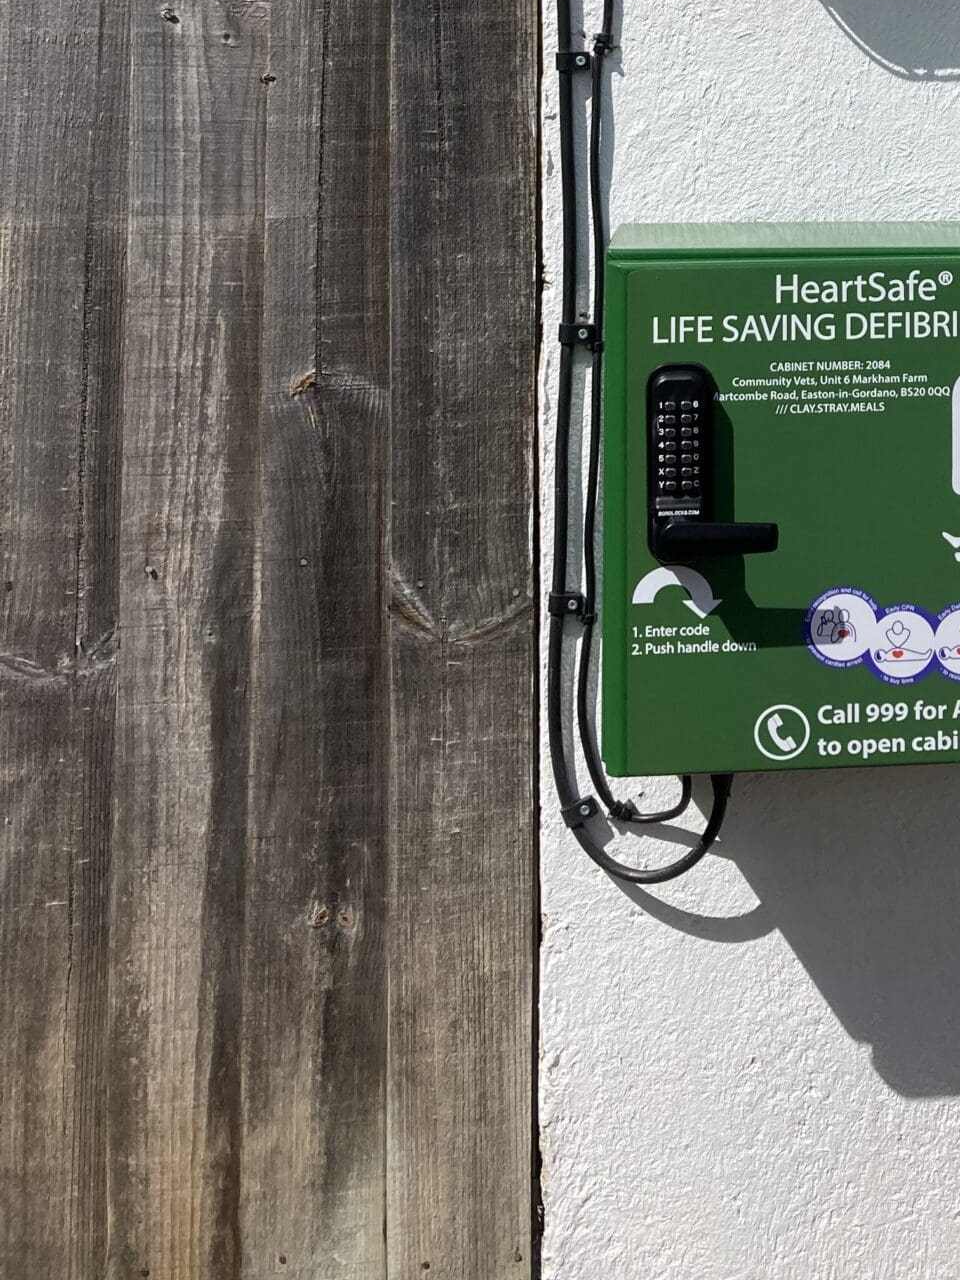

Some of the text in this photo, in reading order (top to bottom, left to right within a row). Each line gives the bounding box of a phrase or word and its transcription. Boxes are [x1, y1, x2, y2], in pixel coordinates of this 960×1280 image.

[653, 316, 713, 344] LIFE
[722, 313, 836, 342] SAVING
[770, 360, 890, 372] CABINET NUMBER: 2084
[732, 373, 927, 388] Community Vets, Unit 6 Markham Farm
[771, 390, 799, 401] Road,
[801, 388, 898, 399] Easton-in-Gordano,
[901, 387, 926, 397] BS20
[928, 387, 950, 397] 0QQ
[790, 402, 885, 414] CLAY.STRAY.MEALS
[659, 428, 664, 436] 3
[632, 624, 710, 638] 1. Enter code
[632, 640, 757, 655] 2. Push handle down
[817, 704, 860, 725] Call
[866, 703, 908, 722] 999
[914, 700, 946, 720] for
[817, 737, 842, 756] to
[847, 736, 906, 758] open
